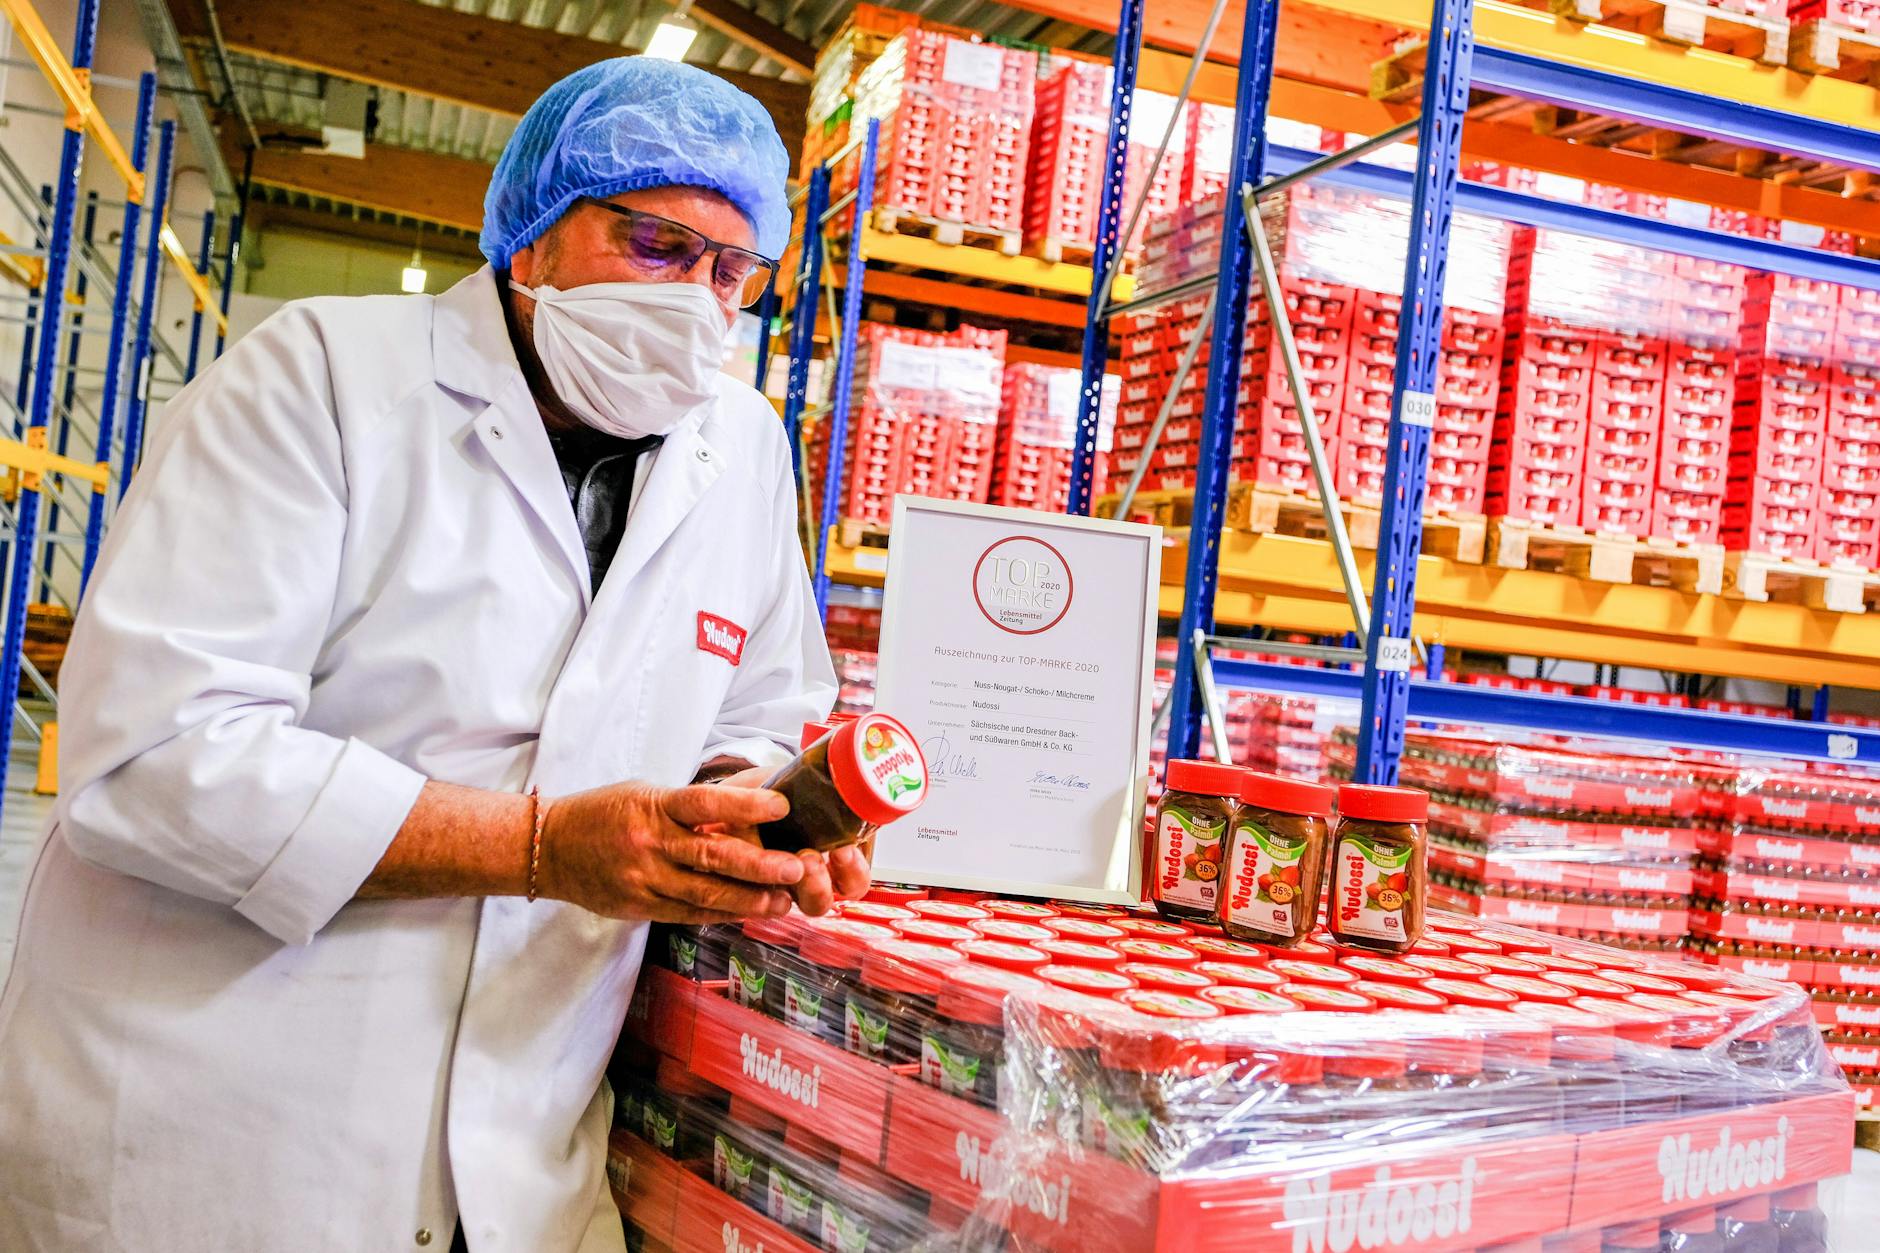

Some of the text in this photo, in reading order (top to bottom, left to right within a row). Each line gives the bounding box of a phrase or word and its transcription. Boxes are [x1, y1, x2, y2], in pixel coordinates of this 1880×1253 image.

[1407, 400, 1432, 416] 030
[989, 556, 1052, 588] TOP
[1040, 582, 1060, 590] 2020
[990, 585, 1054, 608] MARKE
[1000, 610, 1042, 620] Lebensmittel
[1000, 616, 1024, 624] Zeitung
[934, 646, 1100, 673] Auszeichnung zur TOP-MARKE 2020
[1382, 646, 1408, 660] 024
[974, 680, 1094, 701] Nuss-Nougat-/ Schoko-/ Milchcreme
[972, 700, 1000, 710] Nudossi
[970, 720, 1079, 738] Sächsische und Dresdner Back-
[970, 734, 982, 742] und
[984, 734, 1019, 746] Süßwaren
[1020, 738, 1042, 748] GmbH
[1062, 744, 1073, 752] KG
[1192, 816, 1210, 828] OHNE
[917, 833, 940, 842] Zeitung
[918, 826, 958, 836] Lebensmittel
[1190, 826, 1214, 839] Palmöl
[1270, 834, 1290, 848] OHNE
[1266, 845, 1292, 860] Palmöl
[1374, 844, 1394, 856] OHNE
[1162, 826, 1184, 890] Nudossi
[1372, 854, 1398, 868] Palmöl
[1199, 864, 1216, 874] 36%
[1232, 842, 1259, 910] Nudossi
[1272, 886, 1291, 897] 36%
[1341, 856, 1364, 921] Nudossi
[1382, 893, 1400, 904] 36%
[740, 1032, 821, 1109] Nudossi
[1658, 1116, 1789, 1204] Nudossi
[1283, 1156, 1478, 1253] Nudossi
